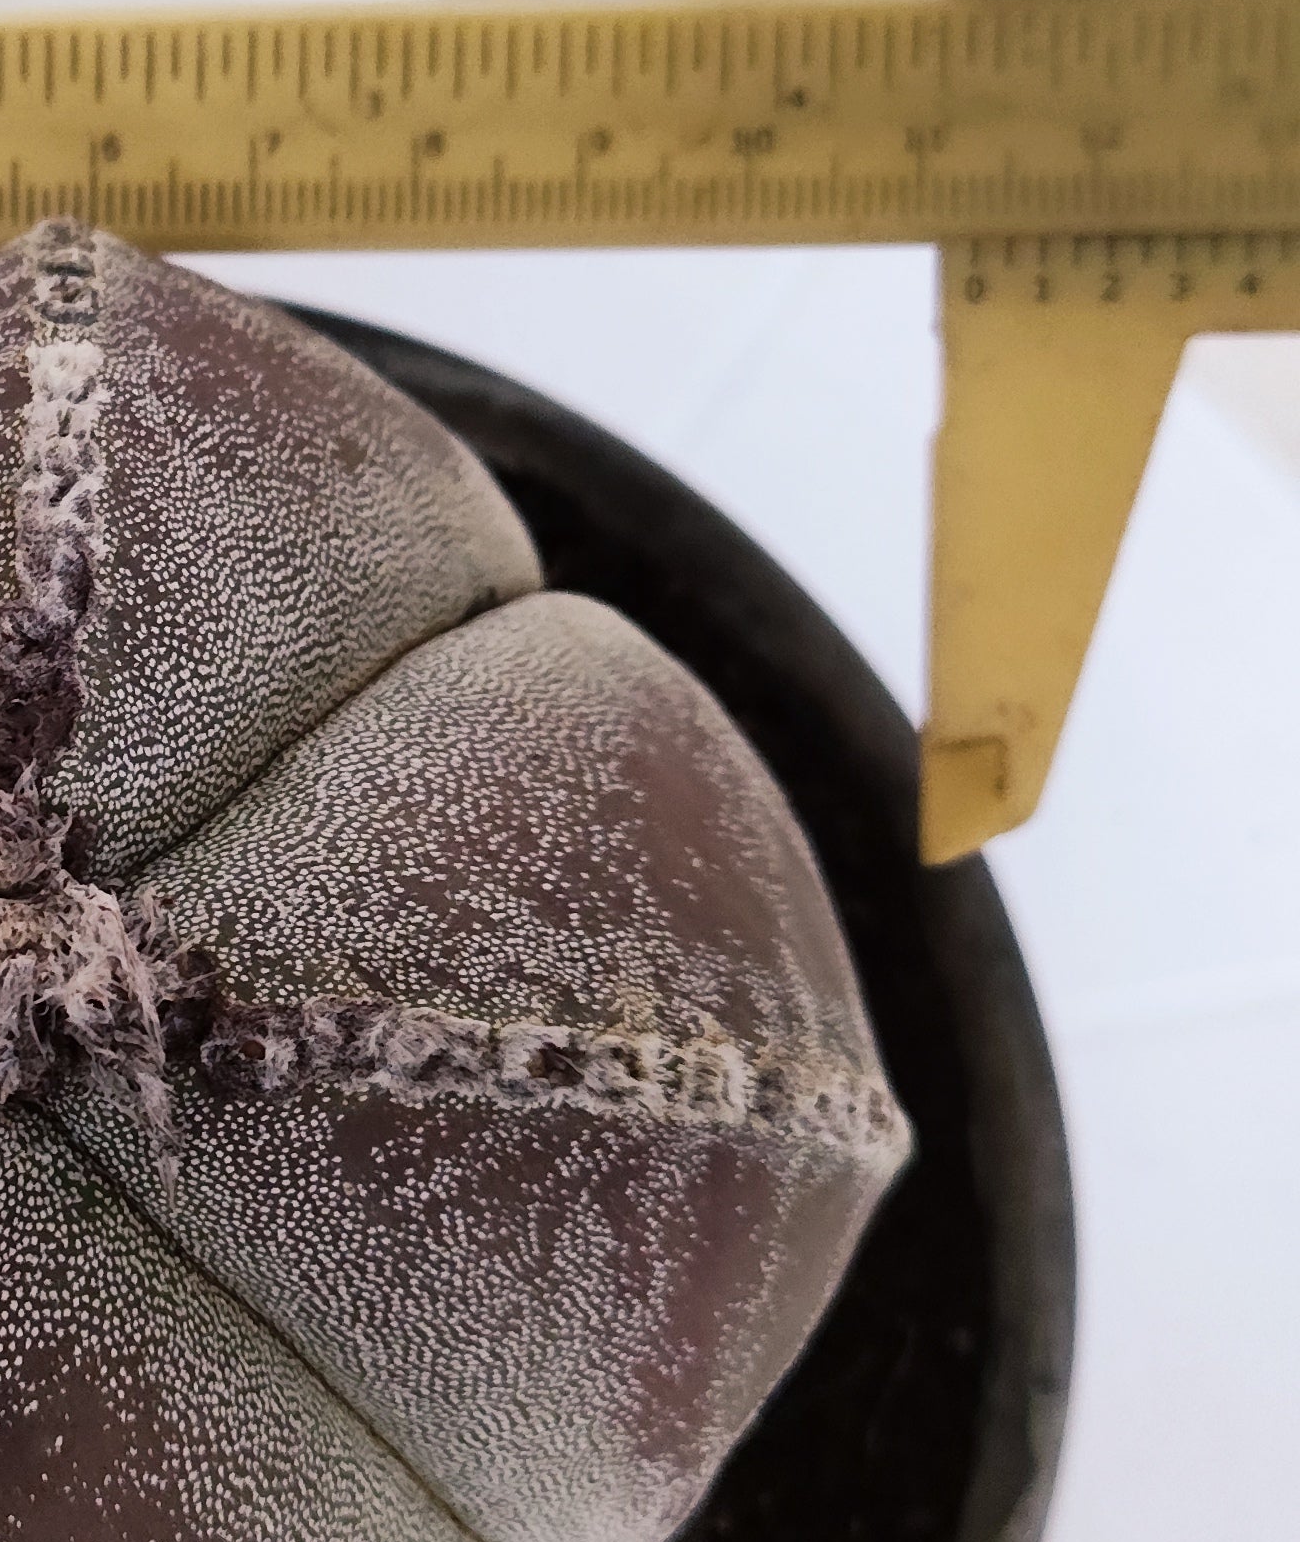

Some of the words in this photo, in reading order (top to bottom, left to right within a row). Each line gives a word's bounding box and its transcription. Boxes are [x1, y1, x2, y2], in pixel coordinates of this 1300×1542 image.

[100, 130, 123, 162] 6
[964, 273, 987, 303] 0
[1035, 274, 1051, 302] 1
[1101, 272, 1122, 302] 2
[1170, 270, 1194, 302] 3
